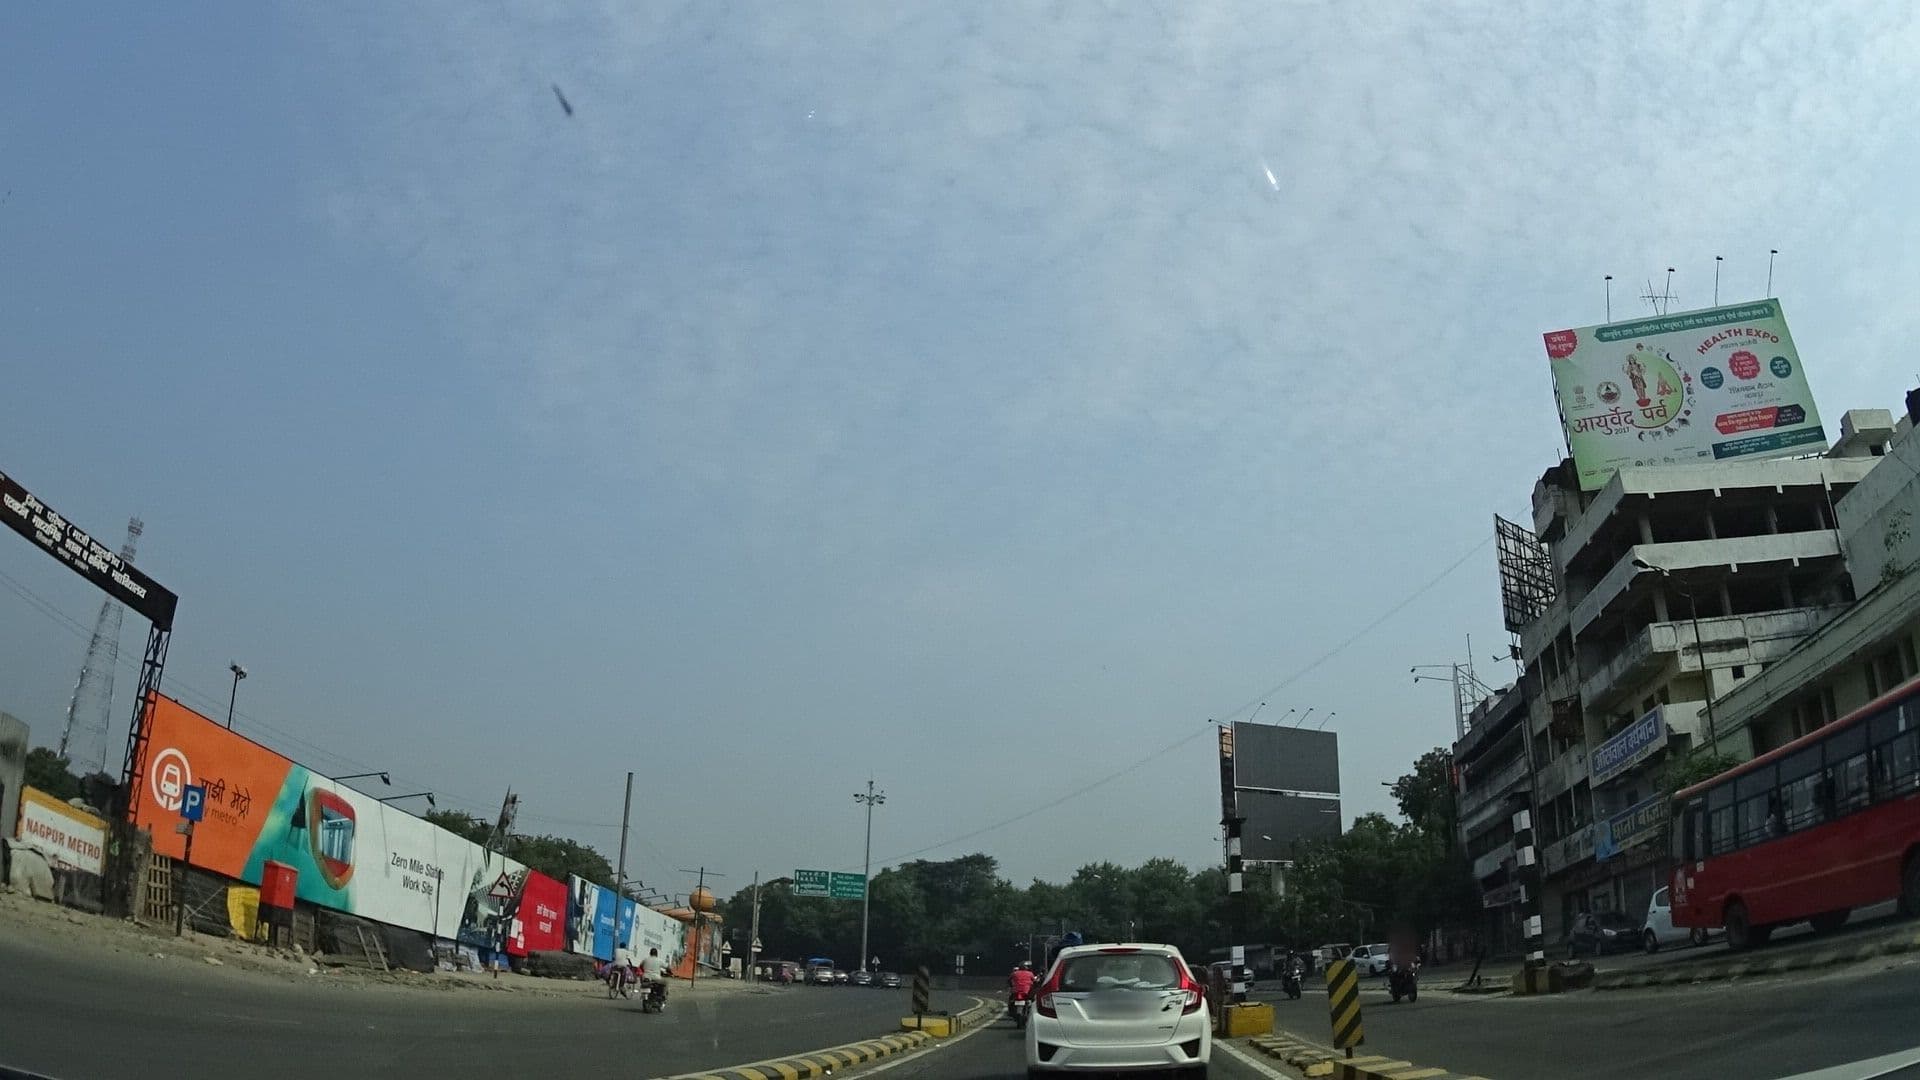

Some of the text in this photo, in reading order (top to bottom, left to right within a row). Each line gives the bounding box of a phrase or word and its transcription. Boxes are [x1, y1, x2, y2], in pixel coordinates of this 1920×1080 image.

[1697, 327, 1744, 355] HEALTH
[1746, 327, 1780, 345] EXPO
[1573, 398, 1668, 437] आयुर्वेद पर्व
[1613, 425, 1631, 436] 2017
[185, 790, 200, 814] P
[230, 783, 252, 820] मेट्रो
[211, 808, 238, 826] metro
[26, 818, 101, 860] NAGPUR METRO
[391, 851, 445, 880] Zero Mile Statin
[402, 875, 434, 896] Work Site
